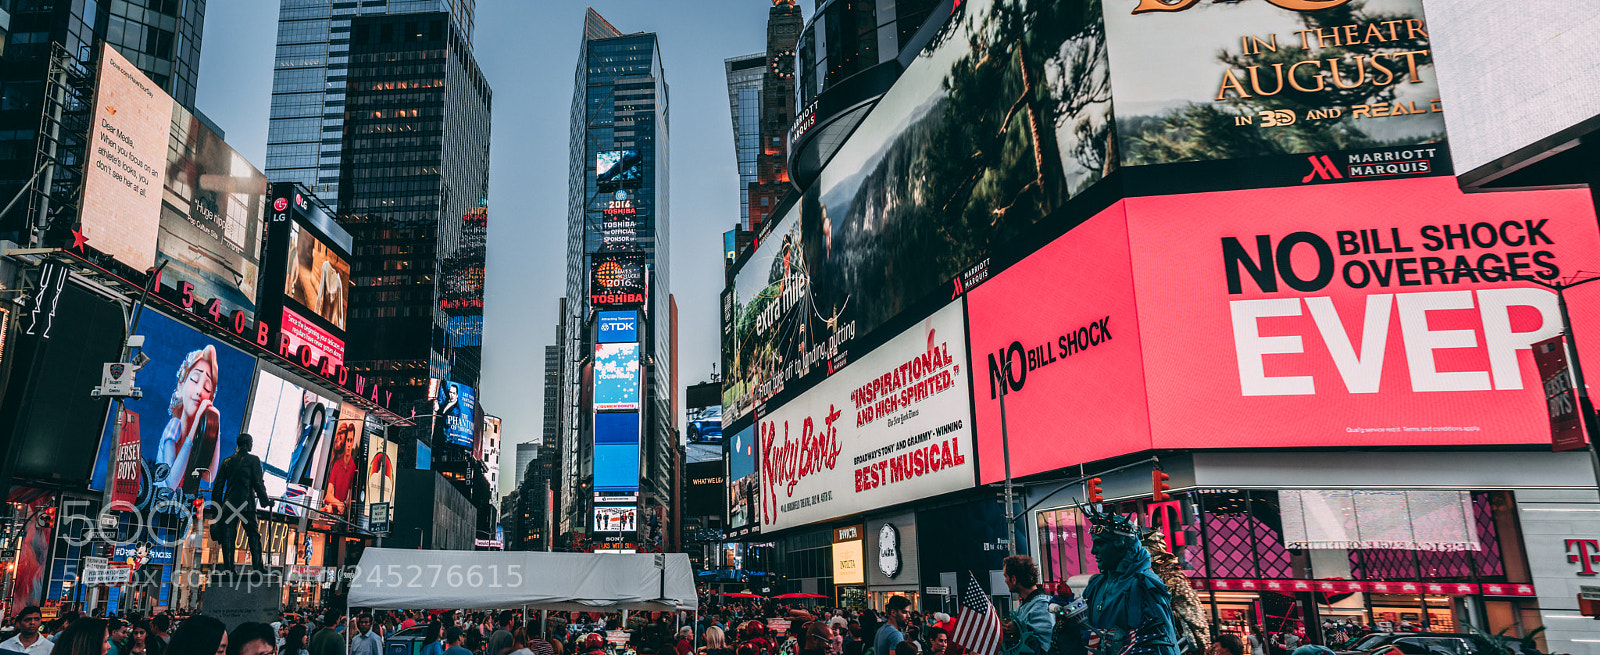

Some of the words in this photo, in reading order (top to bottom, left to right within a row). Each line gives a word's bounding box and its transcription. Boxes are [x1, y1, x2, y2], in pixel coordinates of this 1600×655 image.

[1241, 33, 1277, 55] IN
[1214, 50, 1428, 101] AUGUST
[1235, 116, 1252, 126] IN
[1306, 108, 1341, 121] AND
[101, 118, 116, 133] Dear
[116, 128, 135, 149] Media,
[97, 146, 121, 167] athlete's
[122, 161, 138, 179] looks,
[138, 173, 149, 185] you
[100, 131, 117, 150] When
[117, 145, 128, 157] you
[128, 152, 143, 168] focus
[144, 164, 152, 173] on
[151, 169, 159, 179] an
[1349, 149, 1436, 163] MARRIOTT
[96, 159, 112, 175] don't
[112, 170, 123, 182] see
[123, 175, 133, 188] her
[133, 184, 139, 192] at
[1351, 162, 1429, 176] MARQUIS
[301, 198, 308, 210] LG
[609, 200, 631, 209] 2016
[273, 213, 286, 222] LG
[603, 221, 636, 229] TOSHIBA
[1221, 231, 1335, 295] NO
[1337, 227, 1413, 256] BILL
[1420, 219, 1554, 251] SHOCK
[964, 257, 990, 280] MARRIOTT
[965, 269, 988, 289] MARQUIS
[1342, 251, 1560, 289] OVERAGES
[607, 279, 632, 287] 2016
[592, 294, 643, 304] TOSHIBA
[756, 304, 781, 336] extra
[782, 272, 806, 314] mile
[609, 322, 634, 330] TDK
[829, 320, 856, 357] putting
[257, 322, 392, 409] BROADWAY
[988, 341, 1027, 400] NO
[1027, 341, 1057, 372] BILL
[1058, 315, 1113, 359] SHOCK
[856, 406, 874, 428] AND
[896, 439, 906, 451] AND
[935, 420, 963, 436] WINNING
[117, 443, 141, 461] JERSEY
[117, 461, 137, 480] BOYS
[761, 420, 799, 525] Kinky
[798, 404, 842, 478] Boots
[854, 460, 888, 493] BEST
[889, 436, 965, 484] MUSICAL
